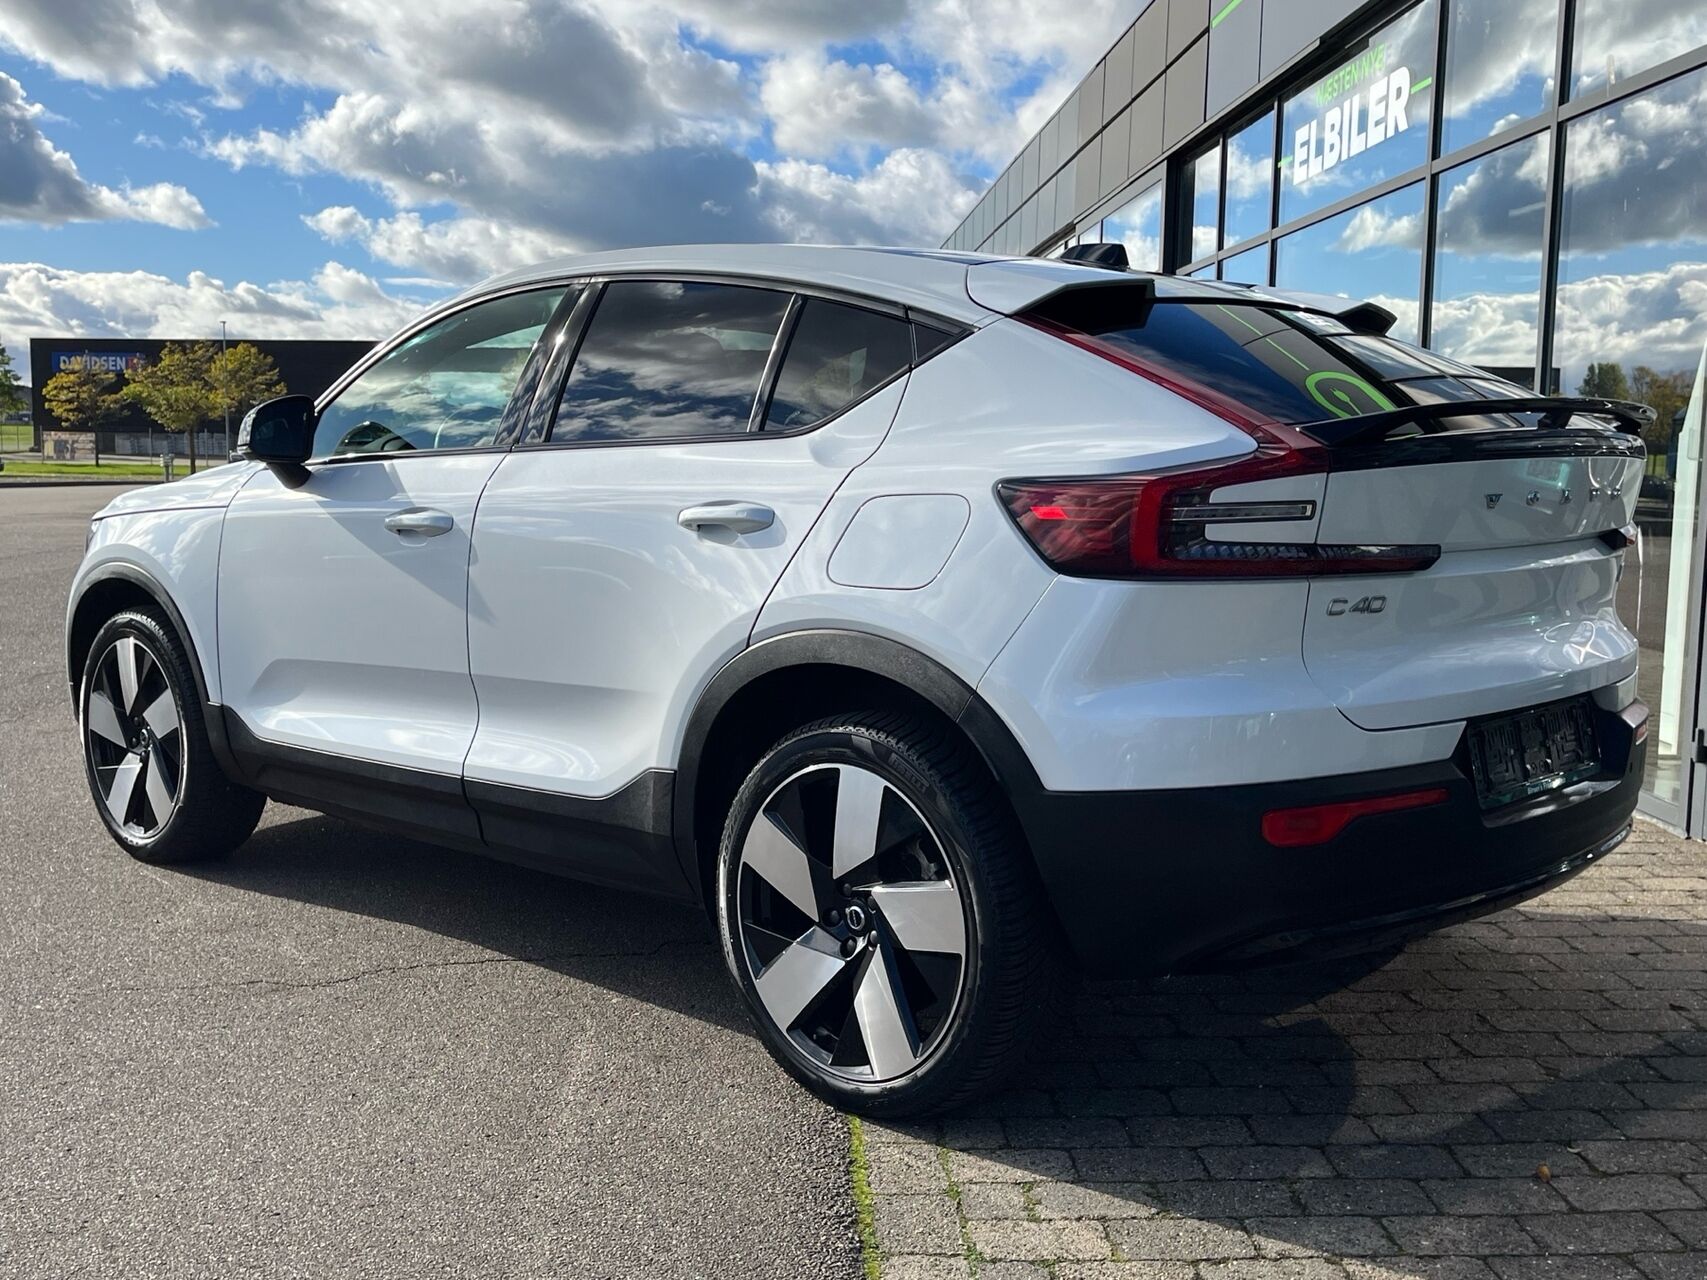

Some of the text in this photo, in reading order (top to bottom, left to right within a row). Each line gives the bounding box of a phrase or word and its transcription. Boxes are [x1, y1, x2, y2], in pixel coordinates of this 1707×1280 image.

[1361, 43, 1386, 77] NYE
[1293, 67, 1410, 185] ELBILER
[1326, 595, 1387, 616] C40
